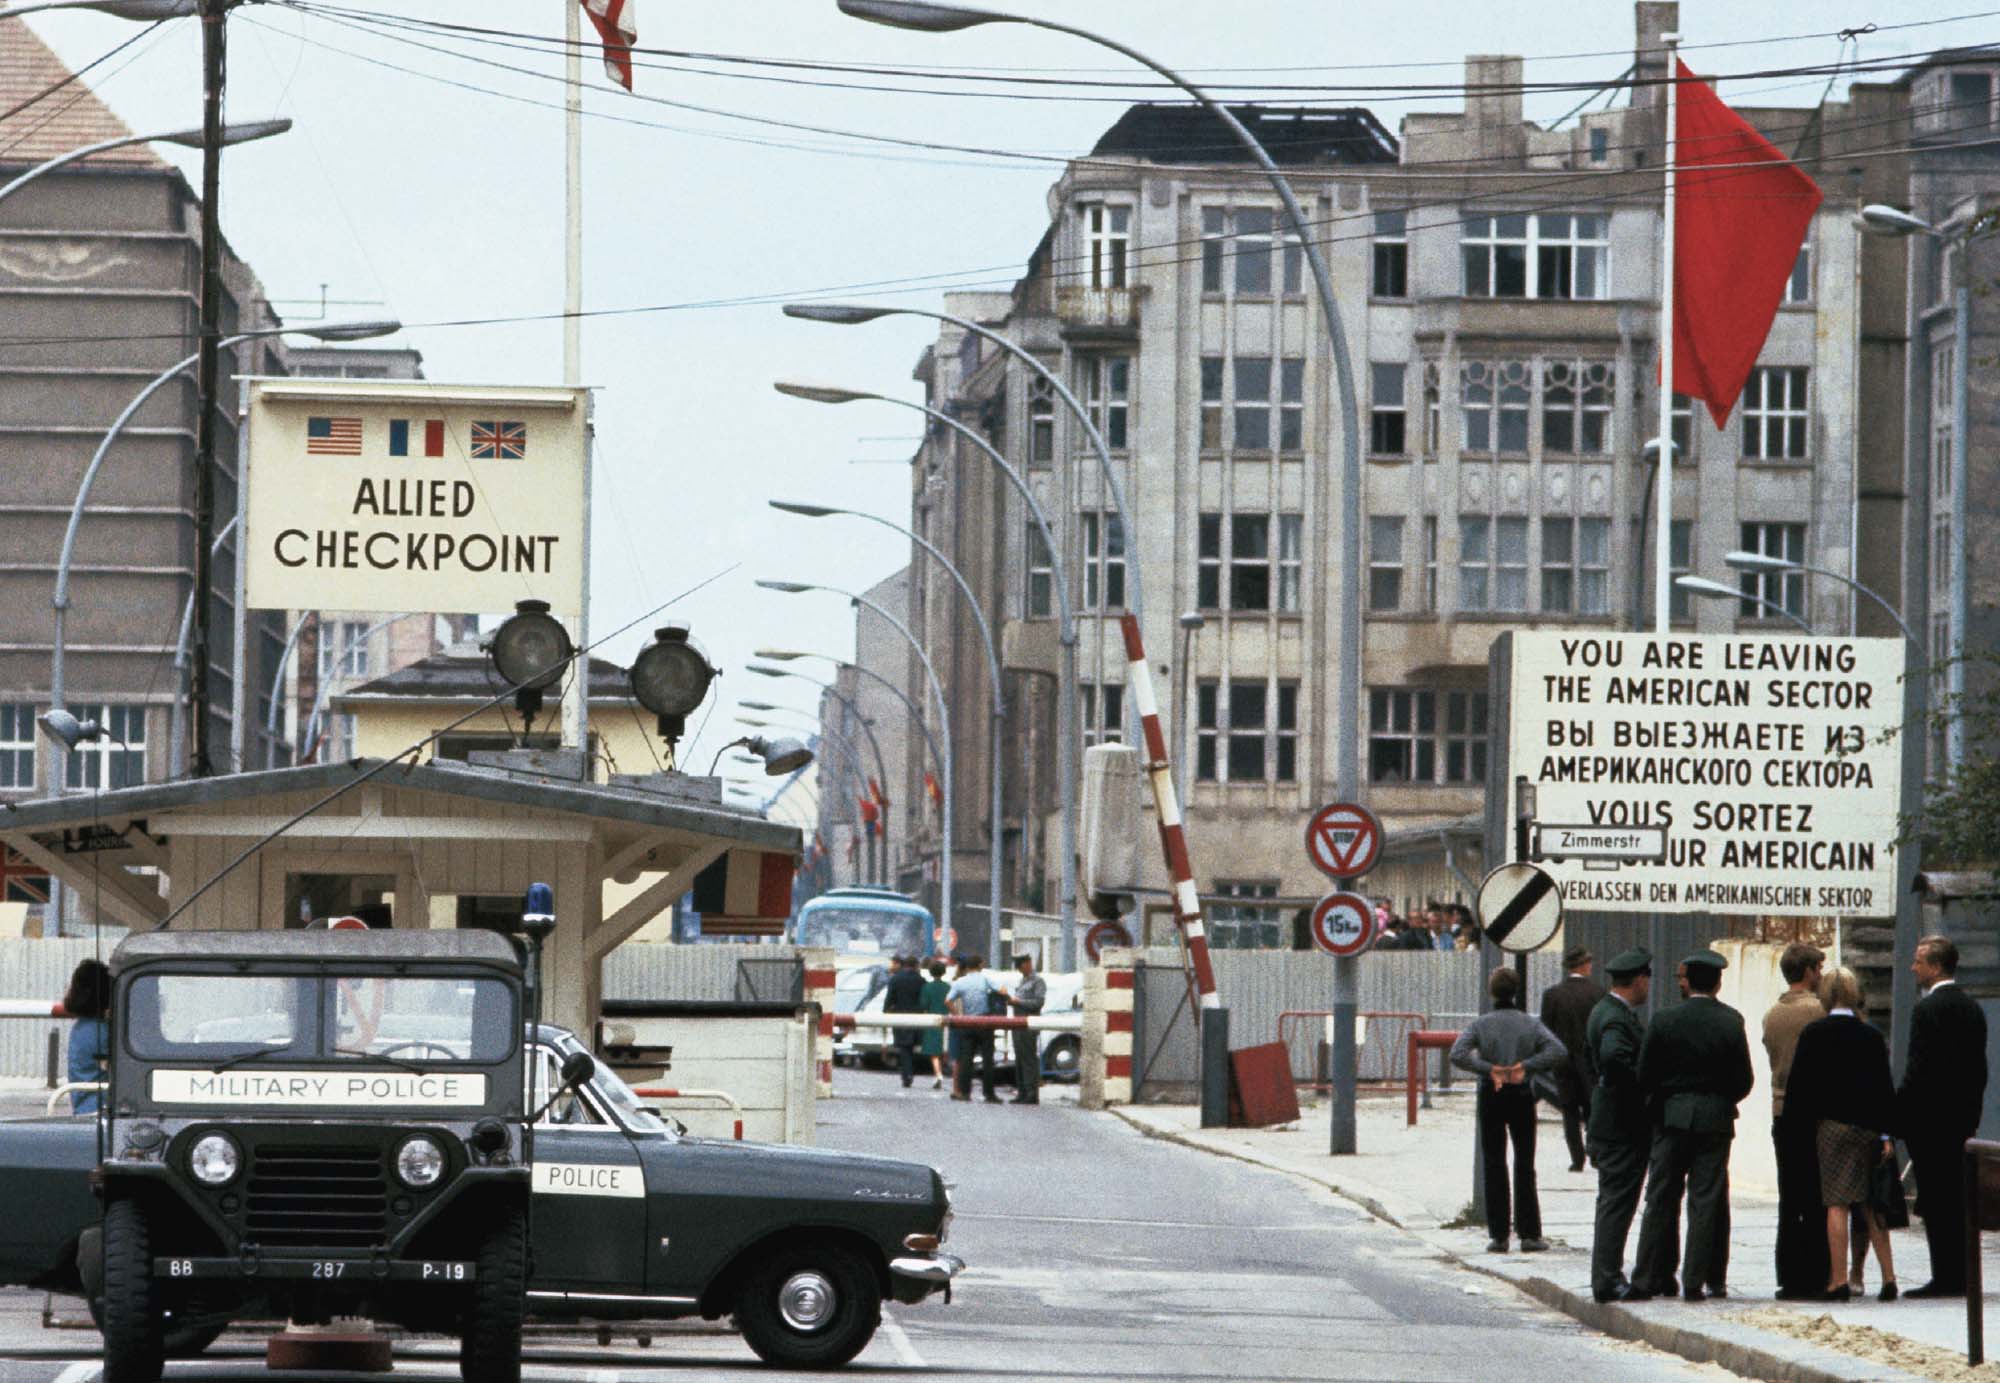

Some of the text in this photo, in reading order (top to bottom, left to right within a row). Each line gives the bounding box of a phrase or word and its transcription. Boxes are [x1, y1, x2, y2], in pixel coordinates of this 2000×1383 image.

[353, 478, 475, 517] ALLIED
[274, 528, 559, 573] CHECKPOINT
[1560, 639, 1856, 673] YOU ARE LEAVING
[1543, 675, 1873, 709] THE AMERICAN SECTOR
[1547, 719, 1865, 753] ВЫ ВЫЕЗЖАЕТЕ ИЗ
[1538, 755, 1873, 789] АМЕРИКАНСКОГО СЕКТОРА
[1587, 800, 1813, 832] VOUS SORTEZ
[1561, 831, 1641, 848] Zimmerstr
[1721, 840, 1874, 871] AMERICAIN
[1560, 881, 1873, 909] VERLASSEN DEN AMERIKANISCHEN SEKTOR
[190, 1077, 458, 1098] MILITARY POLICE
[549, 1166, 621, 1189] POLICE
[170, 1259, 465, 1280] BB 287 P-19
